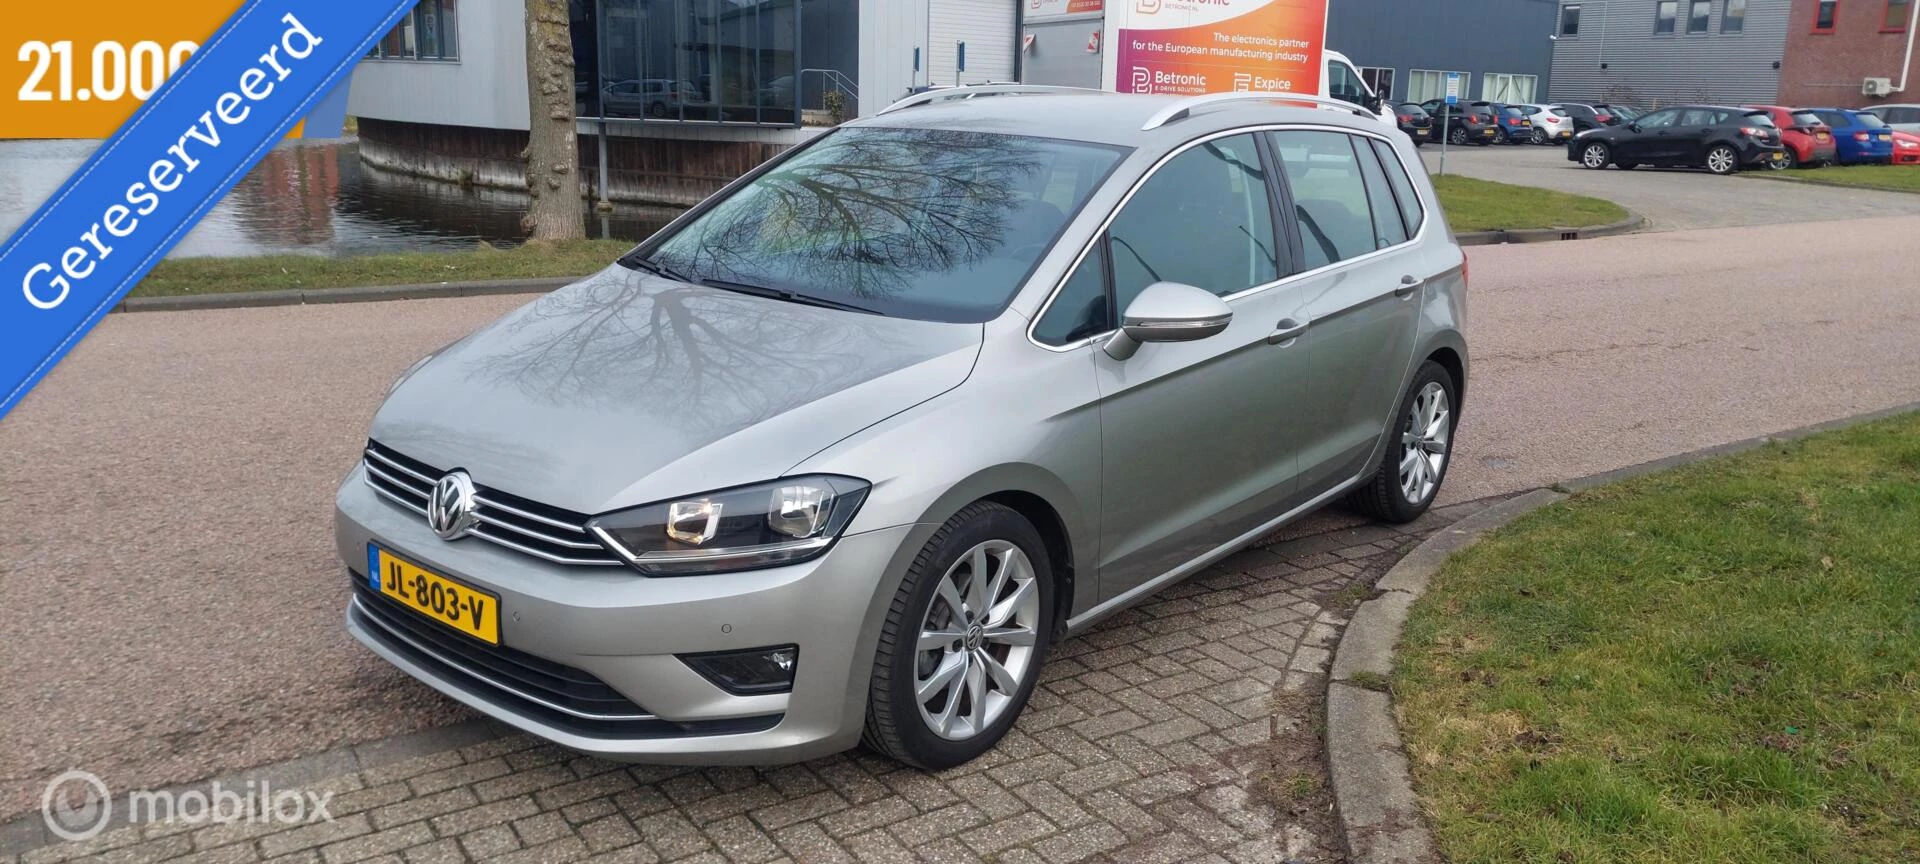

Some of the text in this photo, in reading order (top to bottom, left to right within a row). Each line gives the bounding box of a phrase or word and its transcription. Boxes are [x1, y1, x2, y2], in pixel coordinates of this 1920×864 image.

[1213, 32, 1309, 48] The electronics partner
[1132, 40, 1308, 63] for the European manufacturing industry
[1155, 71, 1206, 85] Betronic
[1254, 76, 1291, 91] Expice
[387, 561, 484, 631] JL-803-V
